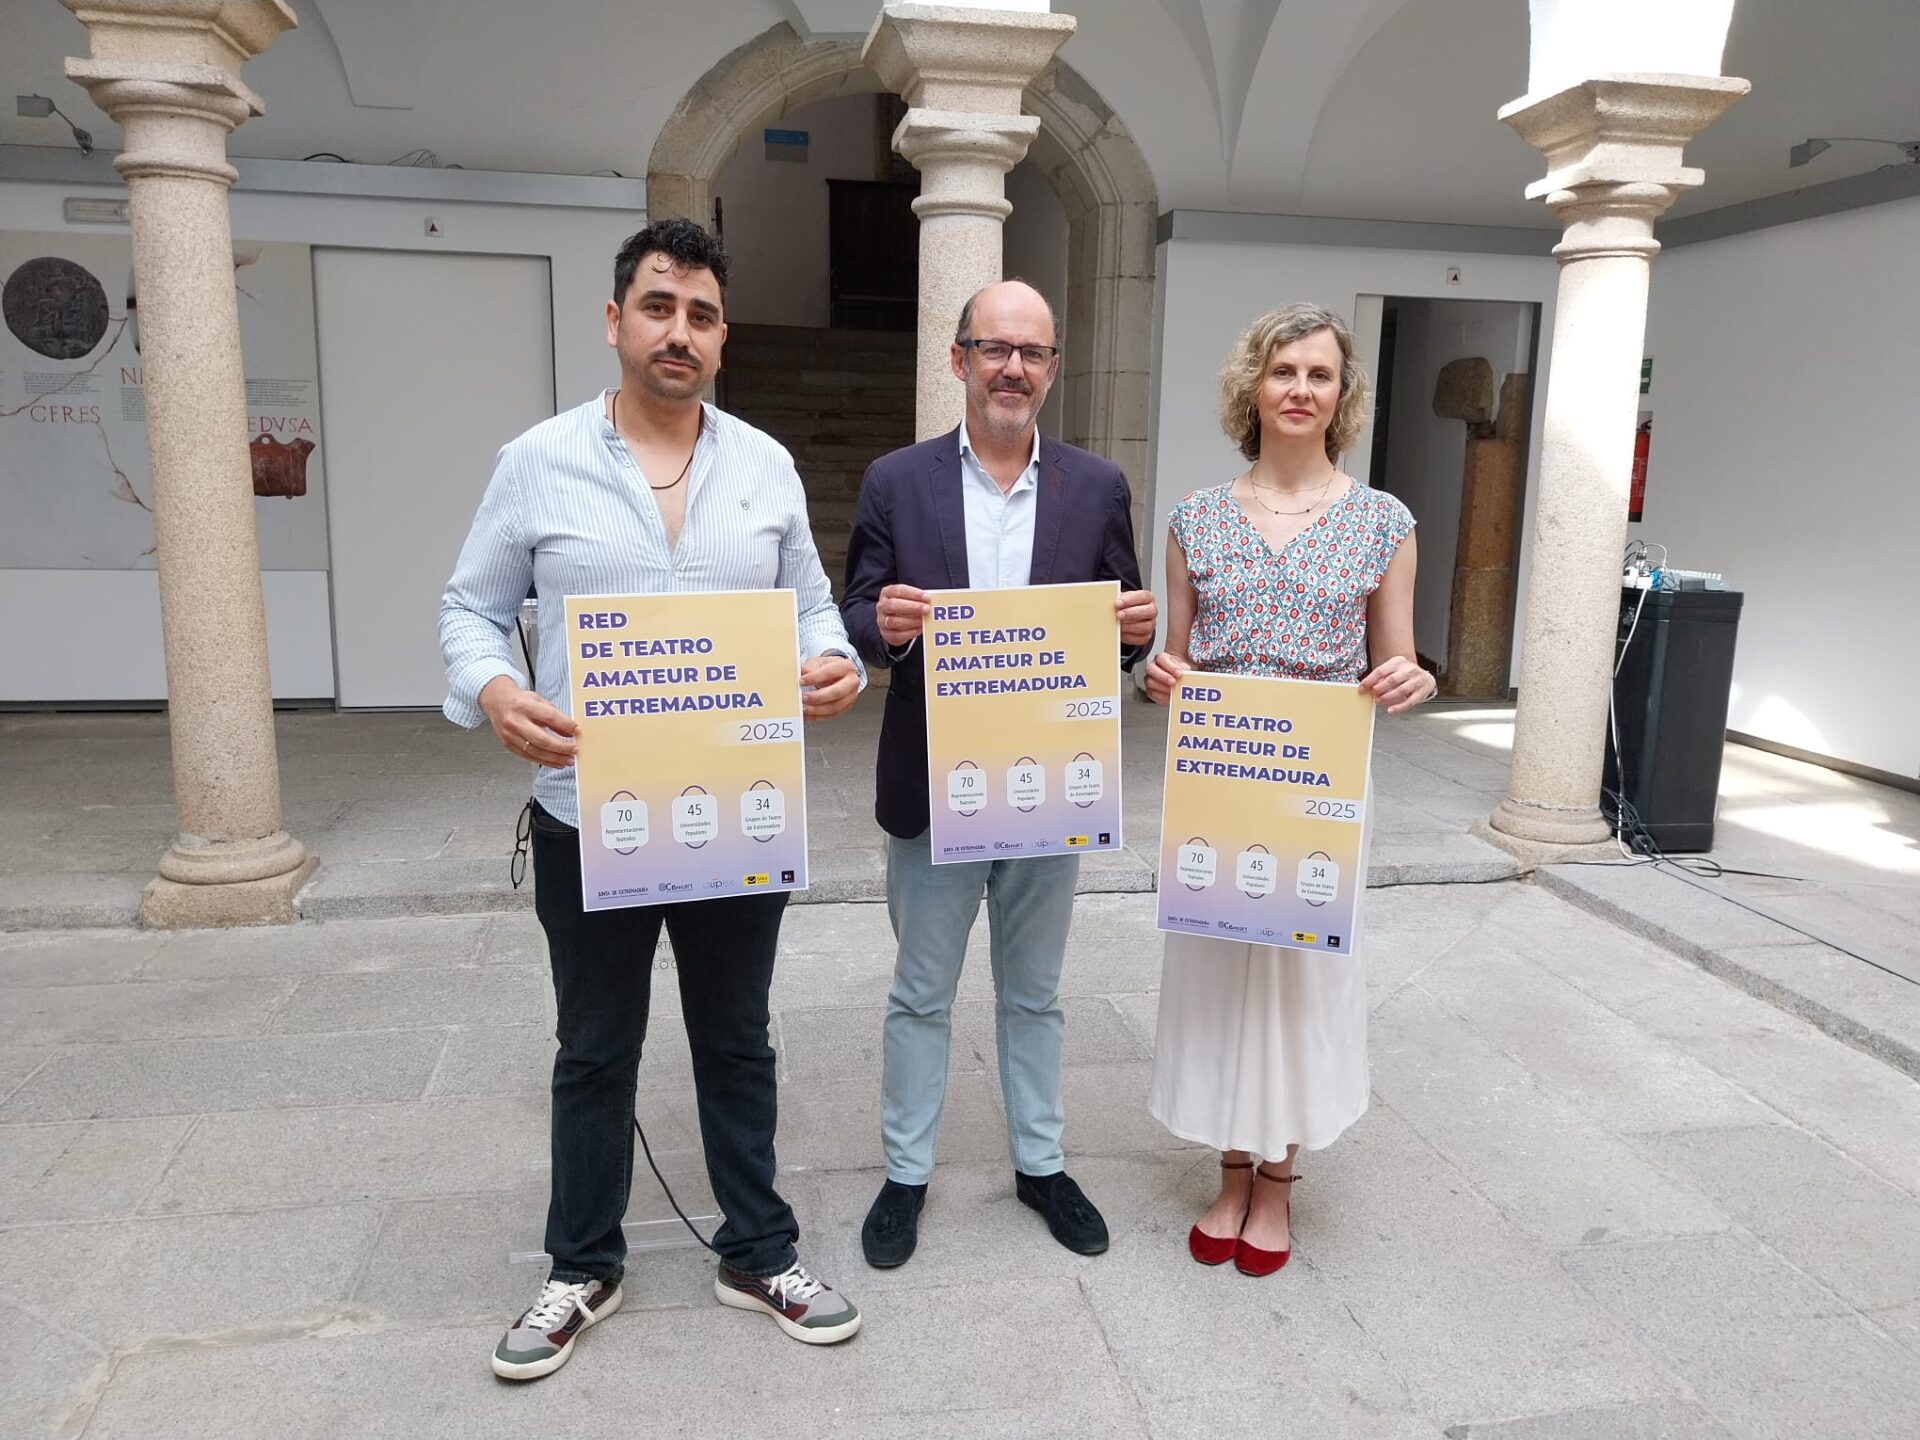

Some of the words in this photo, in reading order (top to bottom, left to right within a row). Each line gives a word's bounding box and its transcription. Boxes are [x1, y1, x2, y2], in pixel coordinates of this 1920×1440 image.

[30, 405, 101, 424] CERES
[247, 416, 314, 433] EDVSA
[579, 612, 628, 630] RED
[933, 605, 975, 621] RED
[934, 631, 961, 646] DE
[967, 627, 1046, 645] TEATRO
[581, 642, 613, 658] DE
[620, 637, 713, 656] TEATRO
[935, 653, 1033, 672] AMATEUR
[1039, 650, 1065, 666] DE
[583, 667, 698, 688] AMATEUR
[706, 665, 737, 682] DE
[936, 674, 1087, 697] EXTREMADURA
[1181, 686, 1221, 702] RED
[584, 692, 764, 717] EXTREMADURA
[1065, 700, 1112, 718] 2025
[1179, 711, 1207, 726] DE
[1212, 713, 1293, 733] TEATRO
[739, 721, 794, 742] 2025
[1177, 735, 1276, 757] AMATEUR
[1283, 744, 1310, 760] DE
[1019, 772, 1033, 784] 45
[1078, 768, 1090, 780] 34
[1176, 758, 1331, 787] EXTREMADURA
[961, 776, 974, 788] 70
[687, 803, 702, 816] 45
[755, 798, 770, 811] 34
[1305, 799, 1356, 819] 2025
[617, 809, 633, 822] 70
[1191, 852, 1204, 864] 70
[1250, 860, 1263, 872] 45
[1311, 867, 1325, 878] 34
